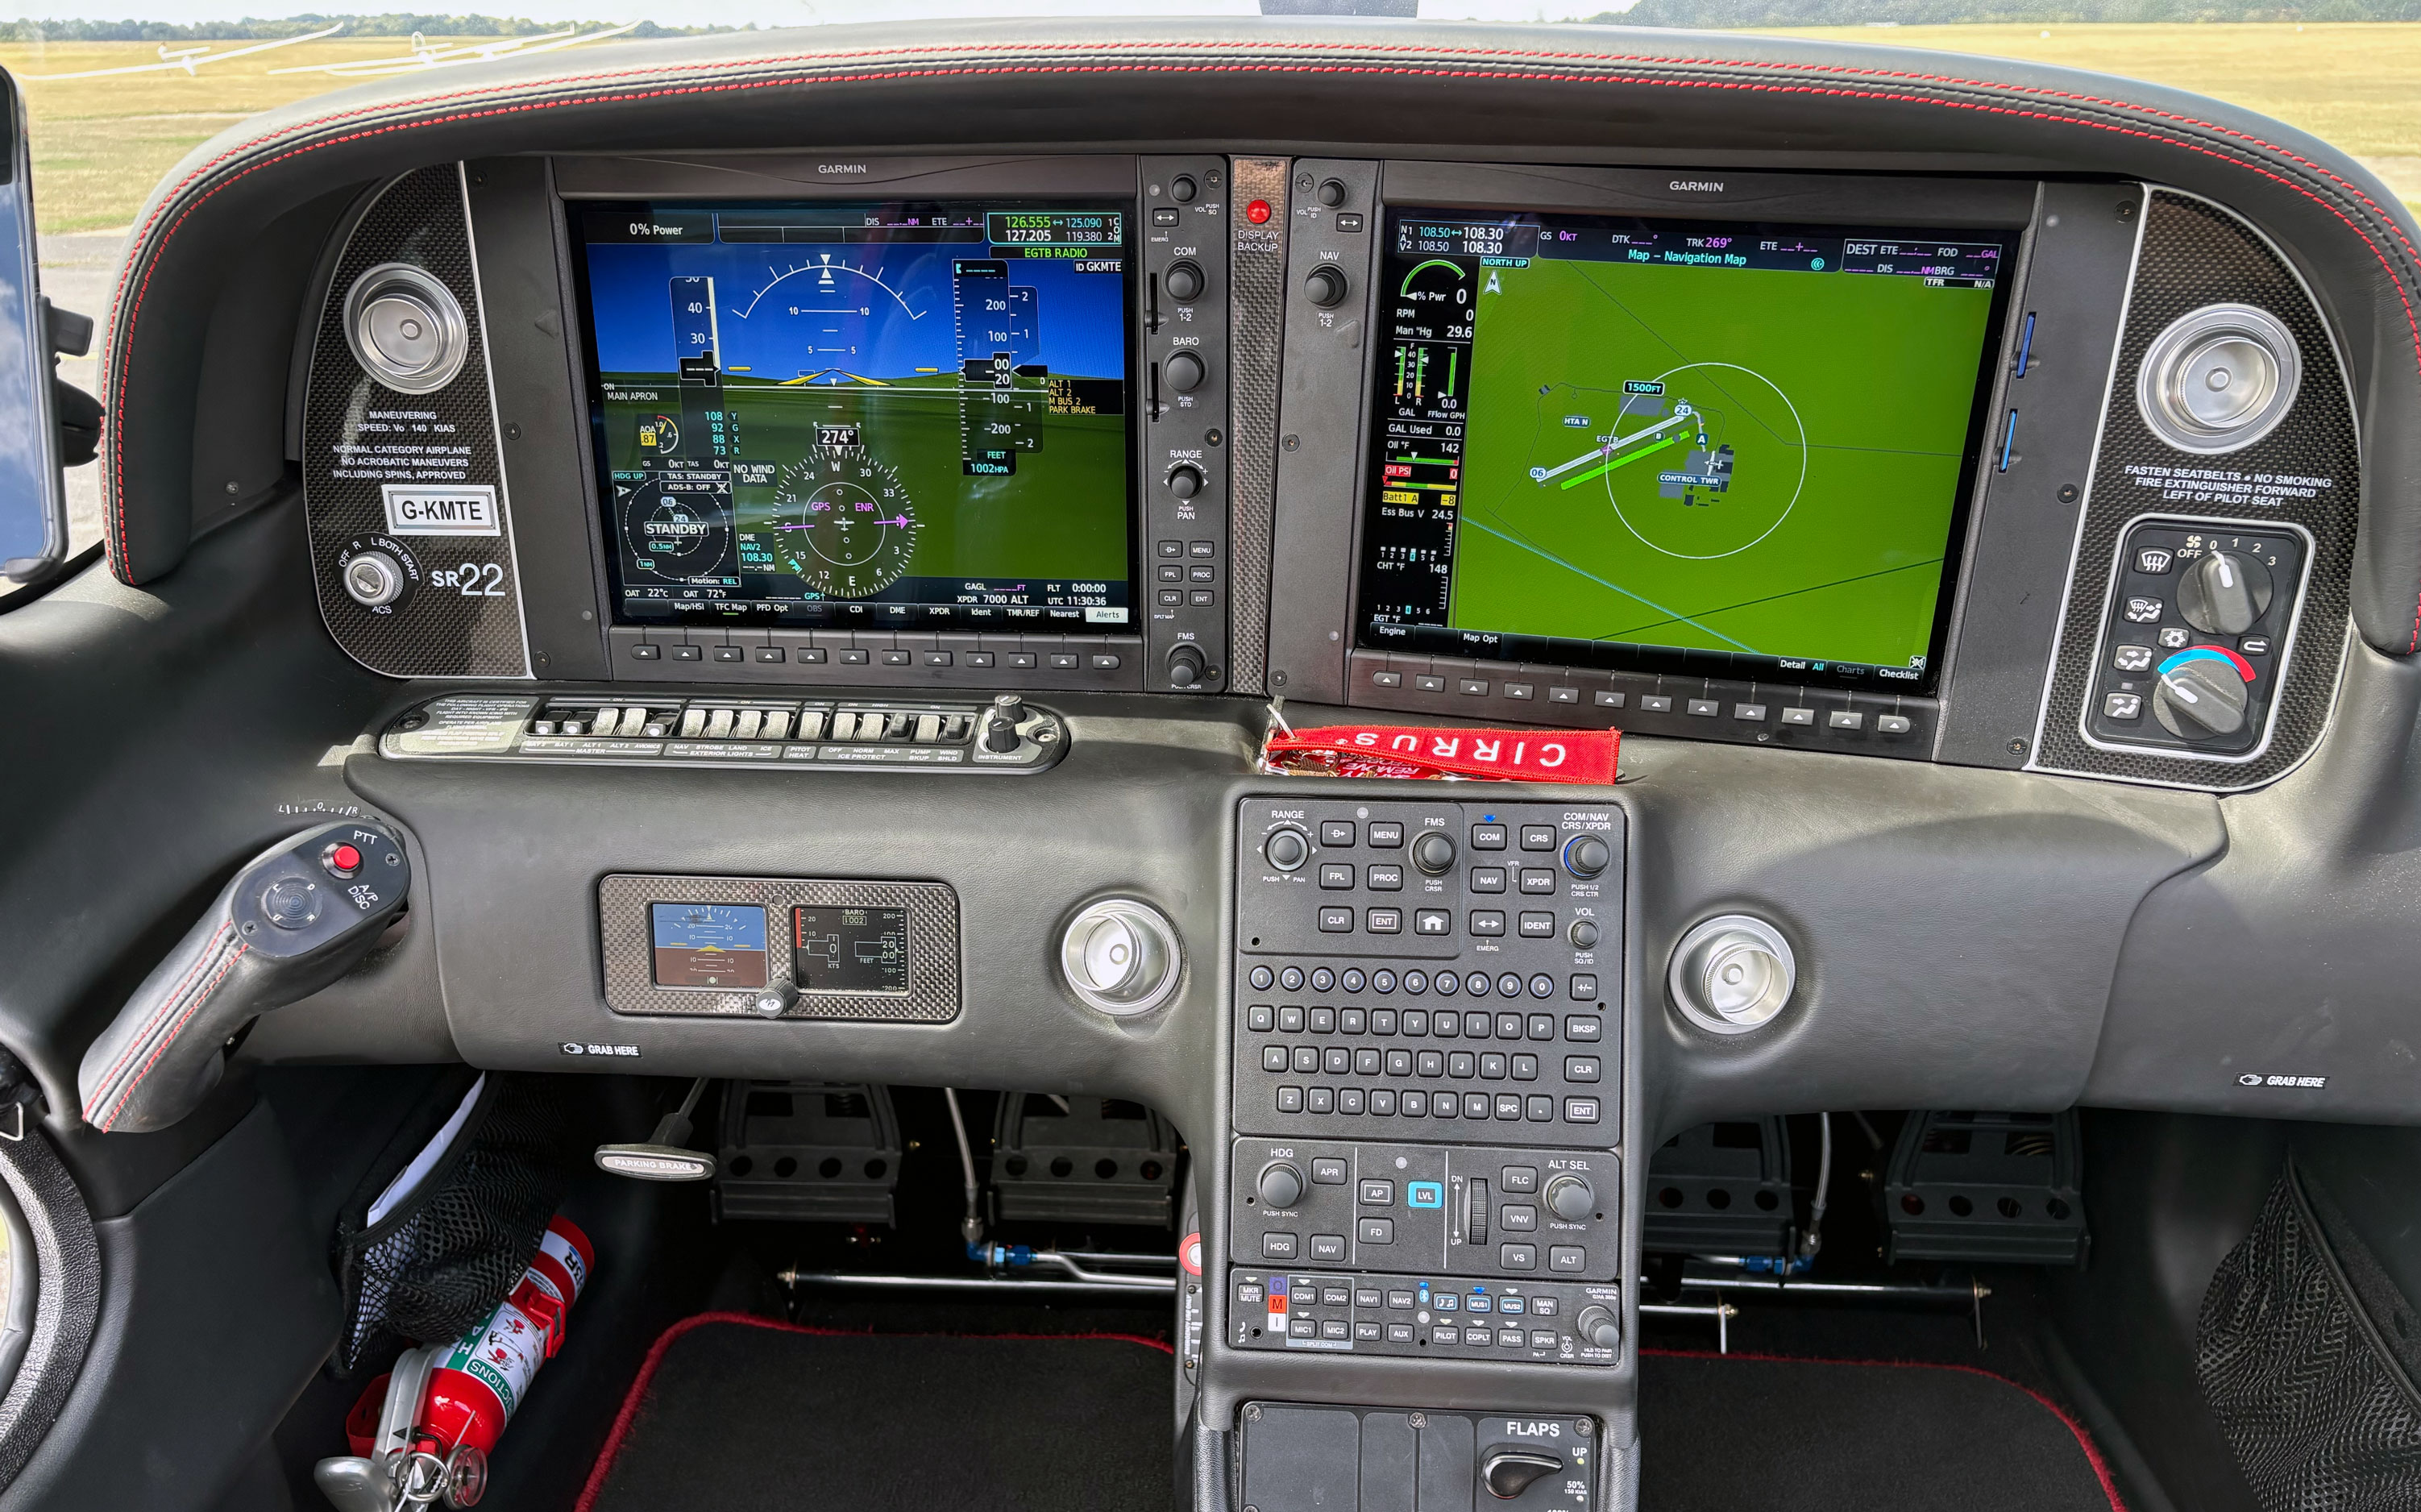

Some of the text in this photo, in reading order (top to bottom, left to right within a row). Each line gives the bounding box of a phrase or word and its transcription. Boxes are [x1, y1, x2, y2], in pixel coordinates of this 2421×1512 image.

[818, 164, 866, 173] GARMIN
[1670, 181, 1723, 192] GARMIN
[1005, 217, 1102, 228] 126.555 125.090
[629, 223, 683, 236] 0% Power
[1419, 226, 1503, 240] 108.50 108.30
[1006, 231, 1102, 241] 127.205 119.380
[1238, 231, 1278, 240] DISPLAY
[1174, 247, 1196, 255] COM
[1238, 243, 1277, 251] BACKUP
[1418, 241, 1502, 254] 108.50 108.30
[1024, 248, 1087, 258] EGTB RADIO
[1320, 251, 1339, 260] NAV
[1628, 250, 1746, 267] Map Navigation Map
[1076, 262, 1121, 272] ID GKMTE
[1975, 280, 1991, 288] N/A
[1628, 384, 1661, 393] 1500FT
[369, 411, 437, 419] MANEUVERING
[358, 423, 391, 432] SPEED:
[1389, 424, 1460, 436] GAL Used 0.0
[334, 446, 471, 455] NORMAL CATEGORY AIRPLANE
[987, 451, 1006, 459] FEET
[342, 458, 468, 467] NO ACROBATIC MANEUVERS
[733, 465, 774, 474] NO WIND
[334, 471, 465, 480] INCLUDING SPINS, APPROVED
[743, 474, 767, 483] DATA
[1660, 475, 1718, 484] CONTROL TWR
[2124, 466, 2332, 488] FASTEN SEATBELTS NO SMOKING
[2136, 477, 2315, 497] FIRE EXTINGUISHER FORWARD
[2163, 490, 2282, 506] LEFT OF PILOT SEAT
[402, 501, 483, 520] G-KMTE
[855, 503, 874, 512] ENR
[1177, 512, 1194, 520] PAN
[646, 525, 705, 534] STANDBY
[379, 538, 402, 555] BOTH
[338, 550, 351, 567] OFF
[741, 553, 773, 562] 108.30
[2177, 549, 2202, 559] OFF
[401, 554, 419, 581] START
[432, 563, 505, 596] SR22
[1072, 584, 1106, 592] 0:00:00
[983, 595, 1007, 604] 7000
[1011, 596, 1028, 604] ALT
[1067, 596, 1106, 605] 11:30:36
[372, 605, 392, 613] ACS
[675, 603, 704, 611] Map/HSI
[732, 604, 747, 612] Map
[1050, 610, 1079, 618] Nearest
[1380, 627, 1406, 635] Engine
[1780, 660, 1805, 669] Detail
[1837, 665, 1864, 675] Charts
[1879, 669, 1918, 679] Checklist
[1356, 733, 1565, 766] CIRRUS
[1425, 818, 1444, 826] FMS
[1562, 822, 1610, 830] CRS/XPDR
[354, 830, 377, 844] PTT
[348, 886, 370, 909] DISC
[588, 1045, 638, 1056] GRAB HERE
[2267, 1076, 2325, 1087] GRAB HERE
[1499, 1104, 1517, 1112] SPC
[1271, 1149, 1294, 1157] HDG
[615, 1159, 691, 1171] PARKING BRAKE
[1549, 1161, 1589, 1170] ALT SEL
[1510, 1215, 1528, 1223] VNV
[1507, 1422, 1559, 1436] FLAPS
[1572, 1448, 1587, 1456] UP
